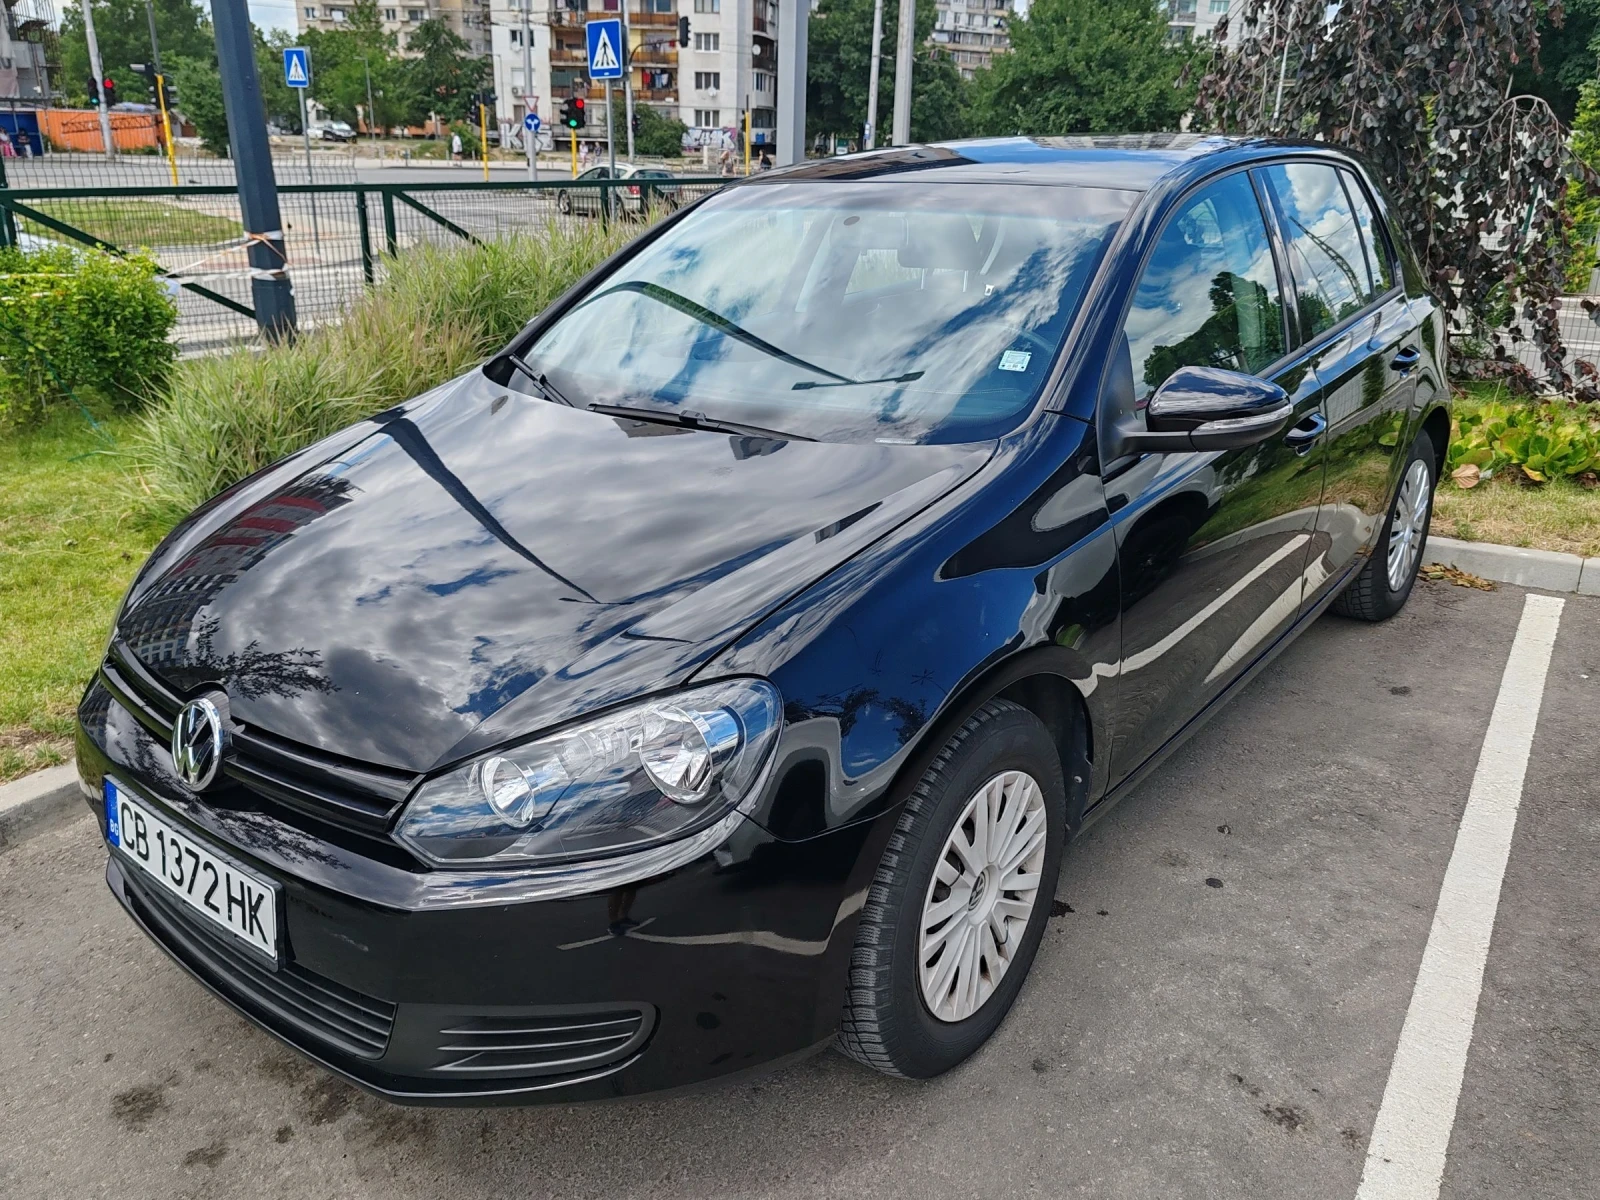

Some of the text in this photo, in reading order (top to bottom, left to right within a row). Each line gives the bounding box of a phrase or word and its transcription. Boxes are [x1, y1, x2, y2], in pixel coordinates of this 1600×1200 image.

[109, 818, 119, 836] BG
[121, 802, 269, 945] CB 1372 HK
